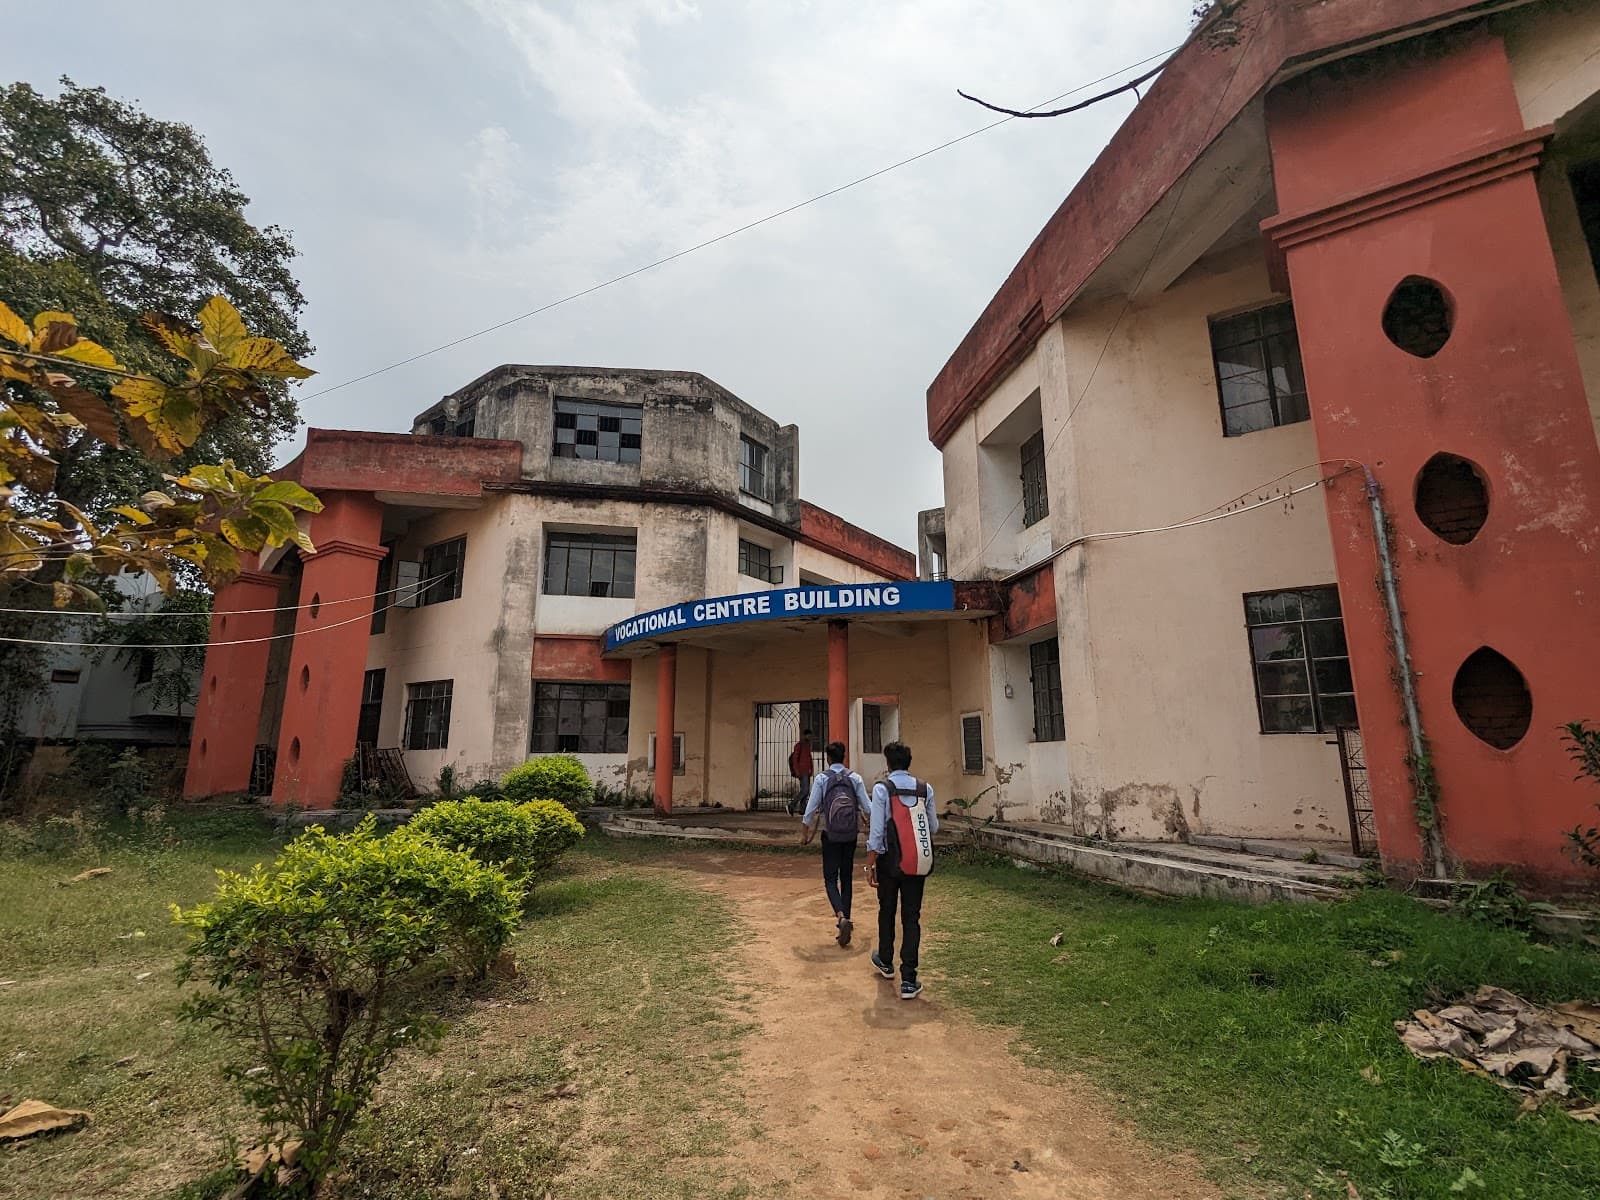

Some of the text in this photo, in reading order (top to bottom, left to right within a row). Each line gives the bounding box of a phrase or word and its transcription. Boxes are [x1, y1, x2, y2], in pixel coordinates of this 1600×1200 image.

[615, 587, 900, 641] VOCATIONAL CENTRE BUILDING
[917, 813, 930, 857] adidas
